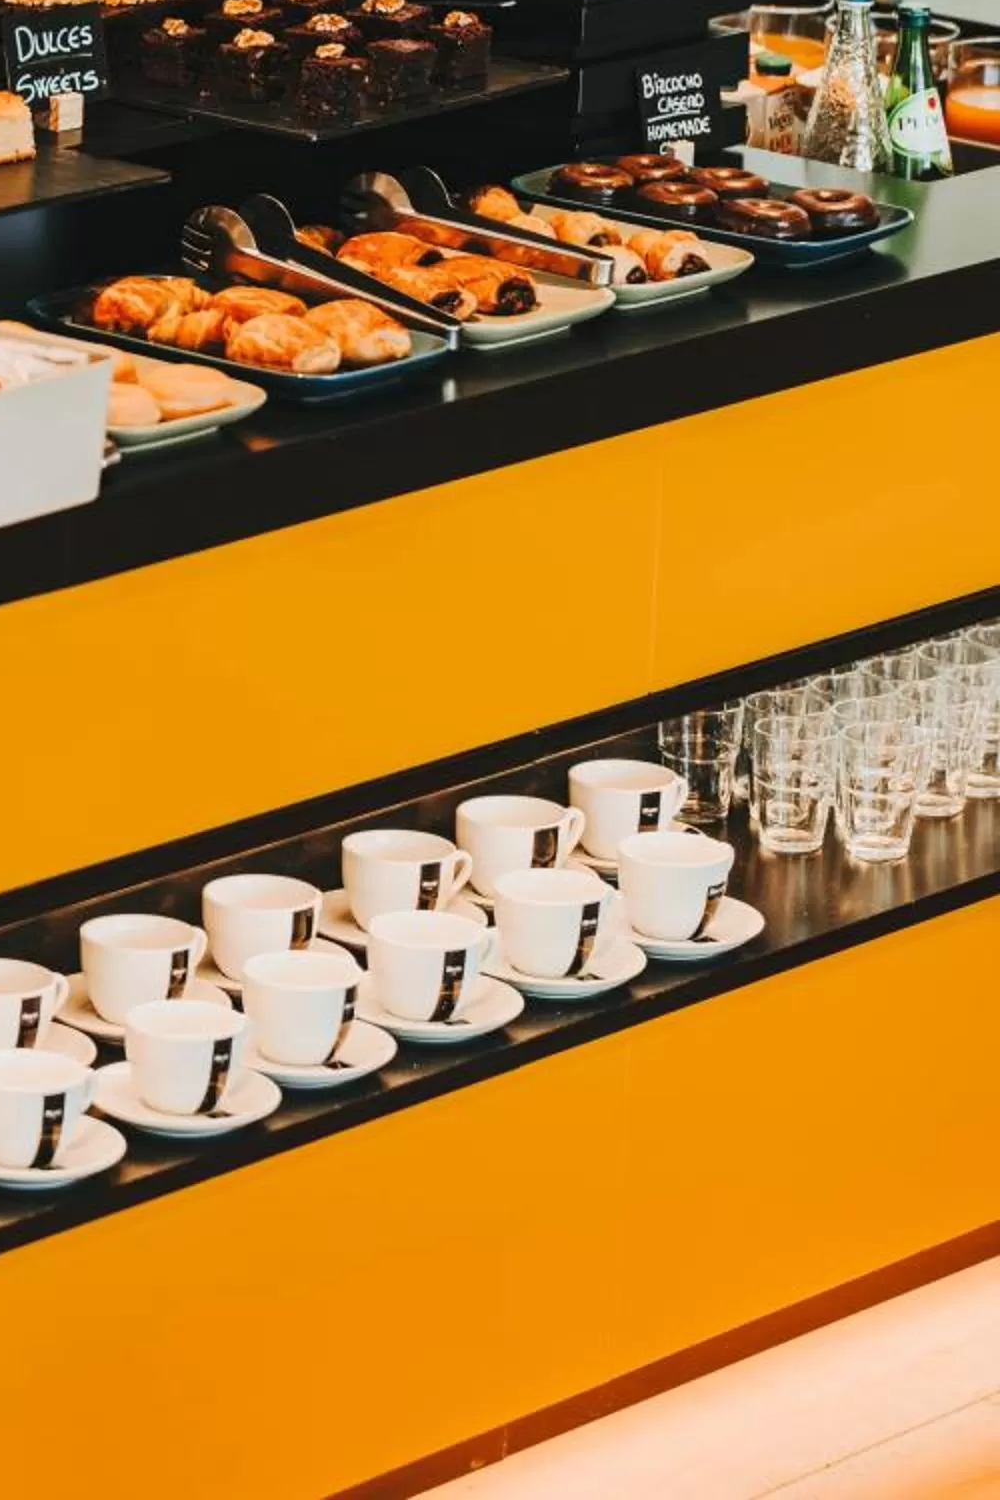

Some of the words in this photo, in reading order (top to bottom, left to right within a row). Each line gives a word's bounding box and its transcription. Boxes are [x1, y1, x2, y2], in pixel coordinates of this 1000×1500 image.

[15, 25, 93, 62] DULCES
[16, 69, 100, 105] SWEETS
[647, 115, 712, 141] HOMEMADE
